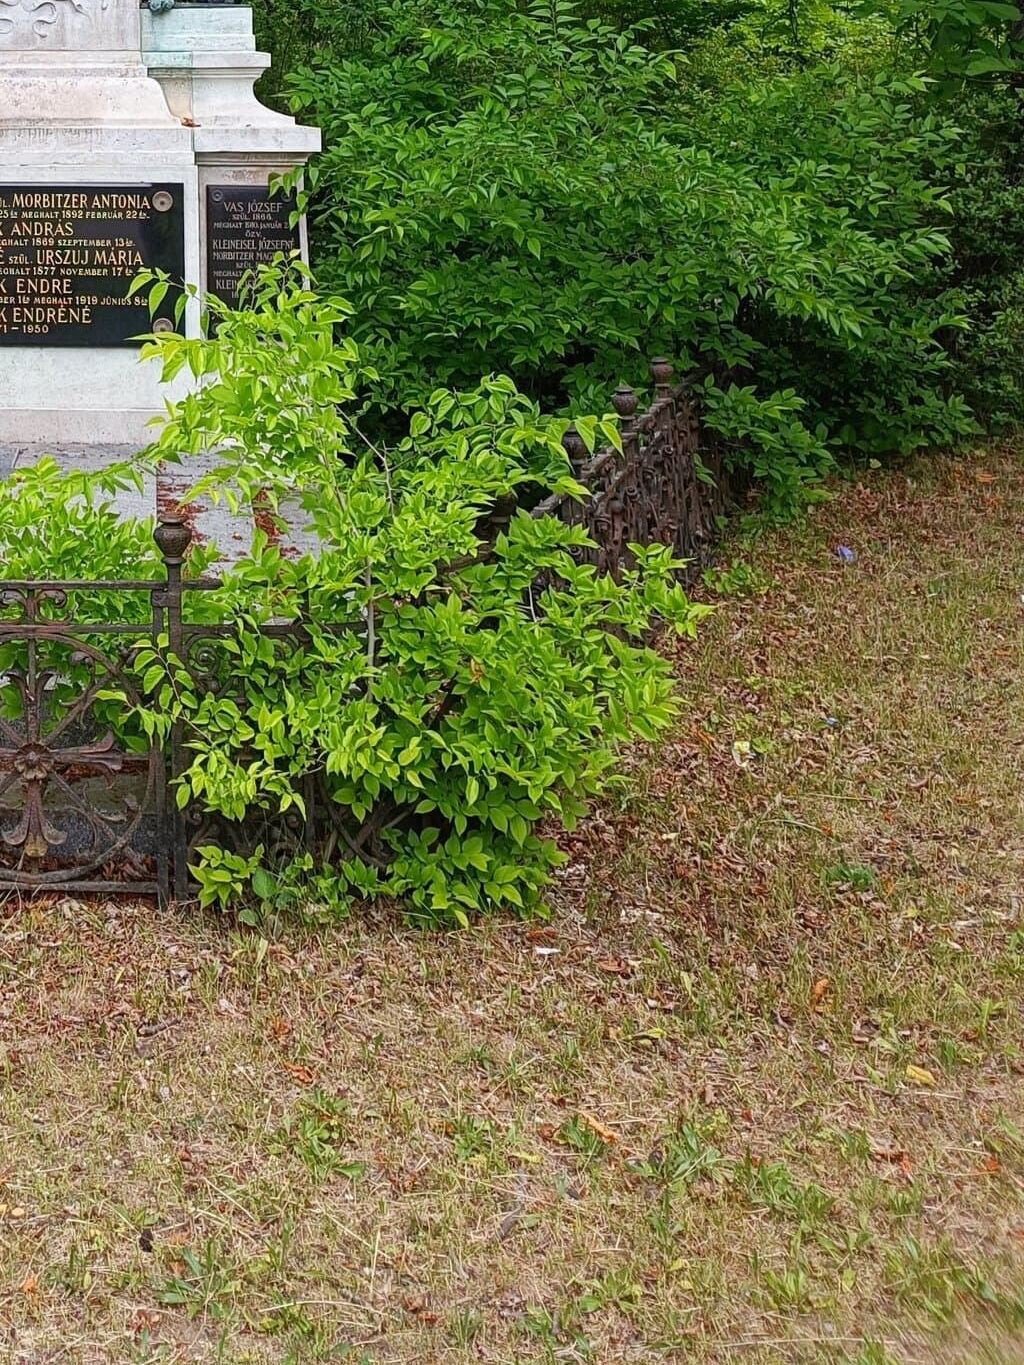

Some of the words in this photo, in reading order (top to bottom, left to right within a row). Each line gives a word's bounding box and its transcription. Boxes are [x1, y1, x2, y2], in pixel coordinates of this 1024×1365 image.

[12, 193, 88, 209] MORBITZER
[91, 194, 151, 209] ANTONIA
[223, 202, 243, 213] VAS
[247, 198, 284, 214] JÓZSEF
[21, 211, 59, 219] MEGHALT
[62, 210, 83, 219] 1892
[85, 210, 123, 219] FEBRUÁR
[11, 218, 74, 237] ANDRÁS
[32, 238, 55, 246] 1869
[212, 239, 256, 250] KLEINEISEL
[36, 250, 89, 266] URSZUJ
[94, 247, 144, 266] MÁRIA
[213, 251, 254, 261] MORBITZER
[33, 267, 56, 275] 1877
[60, 268, 109, 276] NOVEMBER
[16, 278, 73, 294] ENDRE
[33, 296, 73, 305] MEGHALT
[75, 296, 98, 305] 1919
[100, 296, 132, 305] JÚNIUS
[13, 304, 92, 324] ENDRÉNÉ
[23, 324, 49, 334] 1950
